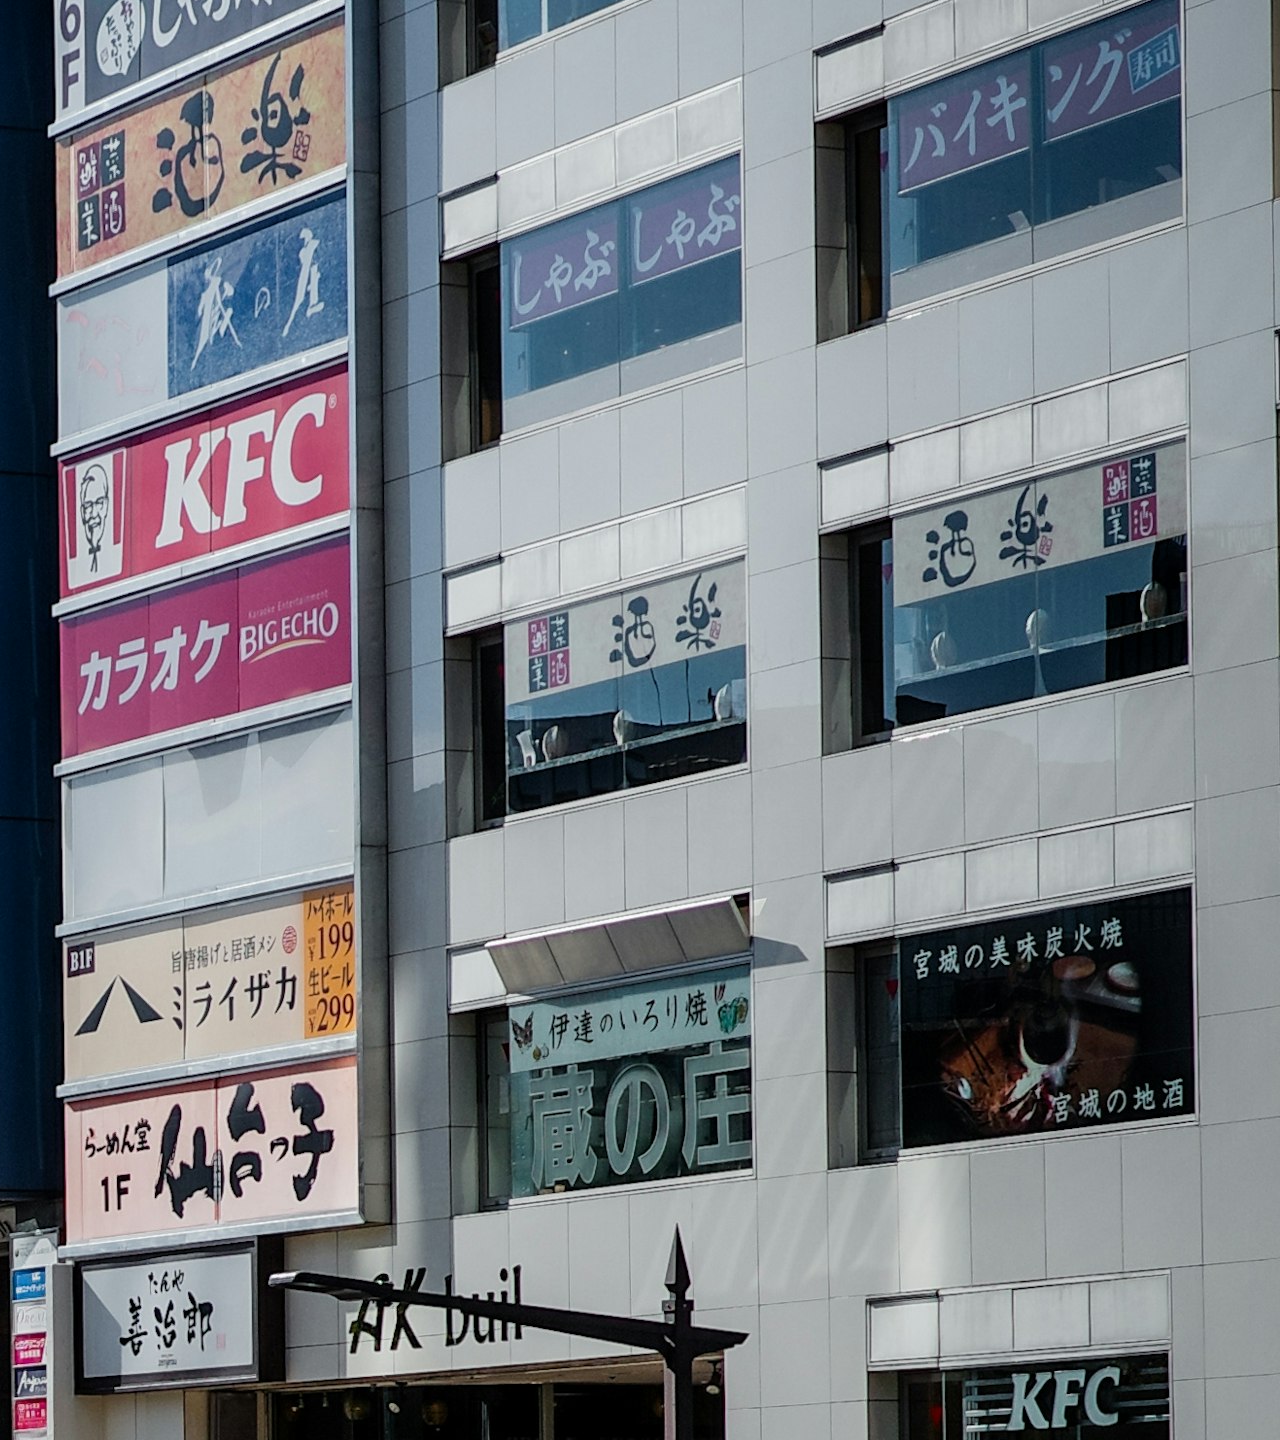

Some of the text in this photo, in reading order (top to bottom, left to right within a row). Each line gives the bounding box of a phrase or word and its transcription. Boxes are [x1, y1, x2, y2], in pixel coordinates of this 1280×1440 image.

[1131, 32, 1179, 88] 寿司
[904, 26, 1132, 176] バイキング
[155, 392, 328, 549] KFC
[240, 602, 339, 663] BIG ECHO
[78, 619, 230, 716] カラオケ
[69, 946, 94, 972] B1F
[307, 963, 354, 998] 生ビール
[912, 916, 1125, 982] 宮城の美味炭火焼
[172, 965, 298, 1031] ミライザカ
[547, 988, 710, 1049] 伊達のいろり焼
[529, 1042, 753, 1191] 蔵の庄
[1052, 1077, 1187, 1124] 宮城の地酒
[84, 1118, 152, 1158] らーめん堂
[154, 1081, 334, 1219] 仙台っ子
[100, 1173, 132, 1212] 1F
[148, 1269, 185, 1295] たんや
[118, 1291, 214, 1357] 善治郎
[1007, 1366, 1122, 1432] KFC
